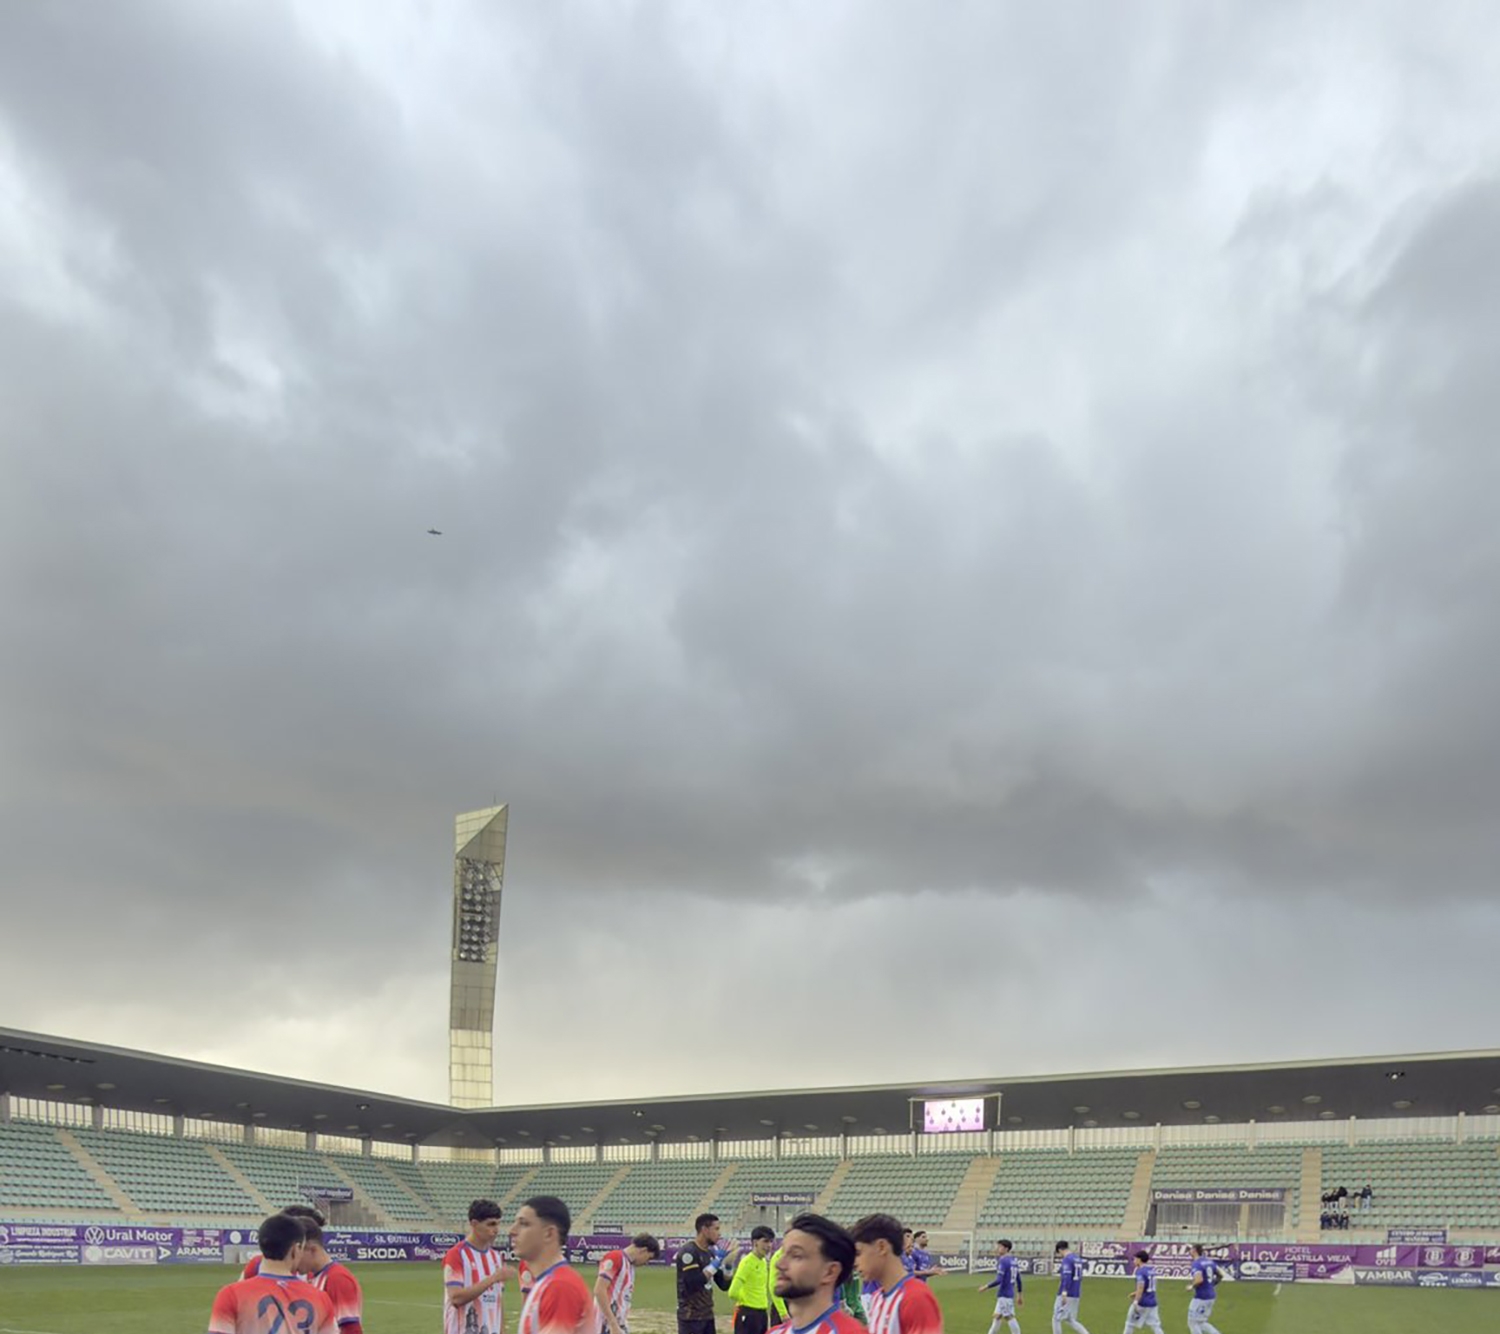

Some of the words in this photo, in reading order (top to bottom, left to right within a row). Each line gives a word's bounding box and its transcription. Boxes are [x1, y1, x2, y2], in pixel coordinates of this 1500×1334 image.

[106, 1228, 133, 1241] Ural
[135, 1229, 173, 1241] Motor
[357, 1248, 407, 1259] SKODA
[1284, 1254, 1323, 1262] CASTILLA
[1327, 1255, 1352, 1263] VIEJA
[940, 1256, 968, 1266] beko
[1082, 1260, 1126, 1277] JOSA
[1366, 1271, 1413, 1280] AMBAR
